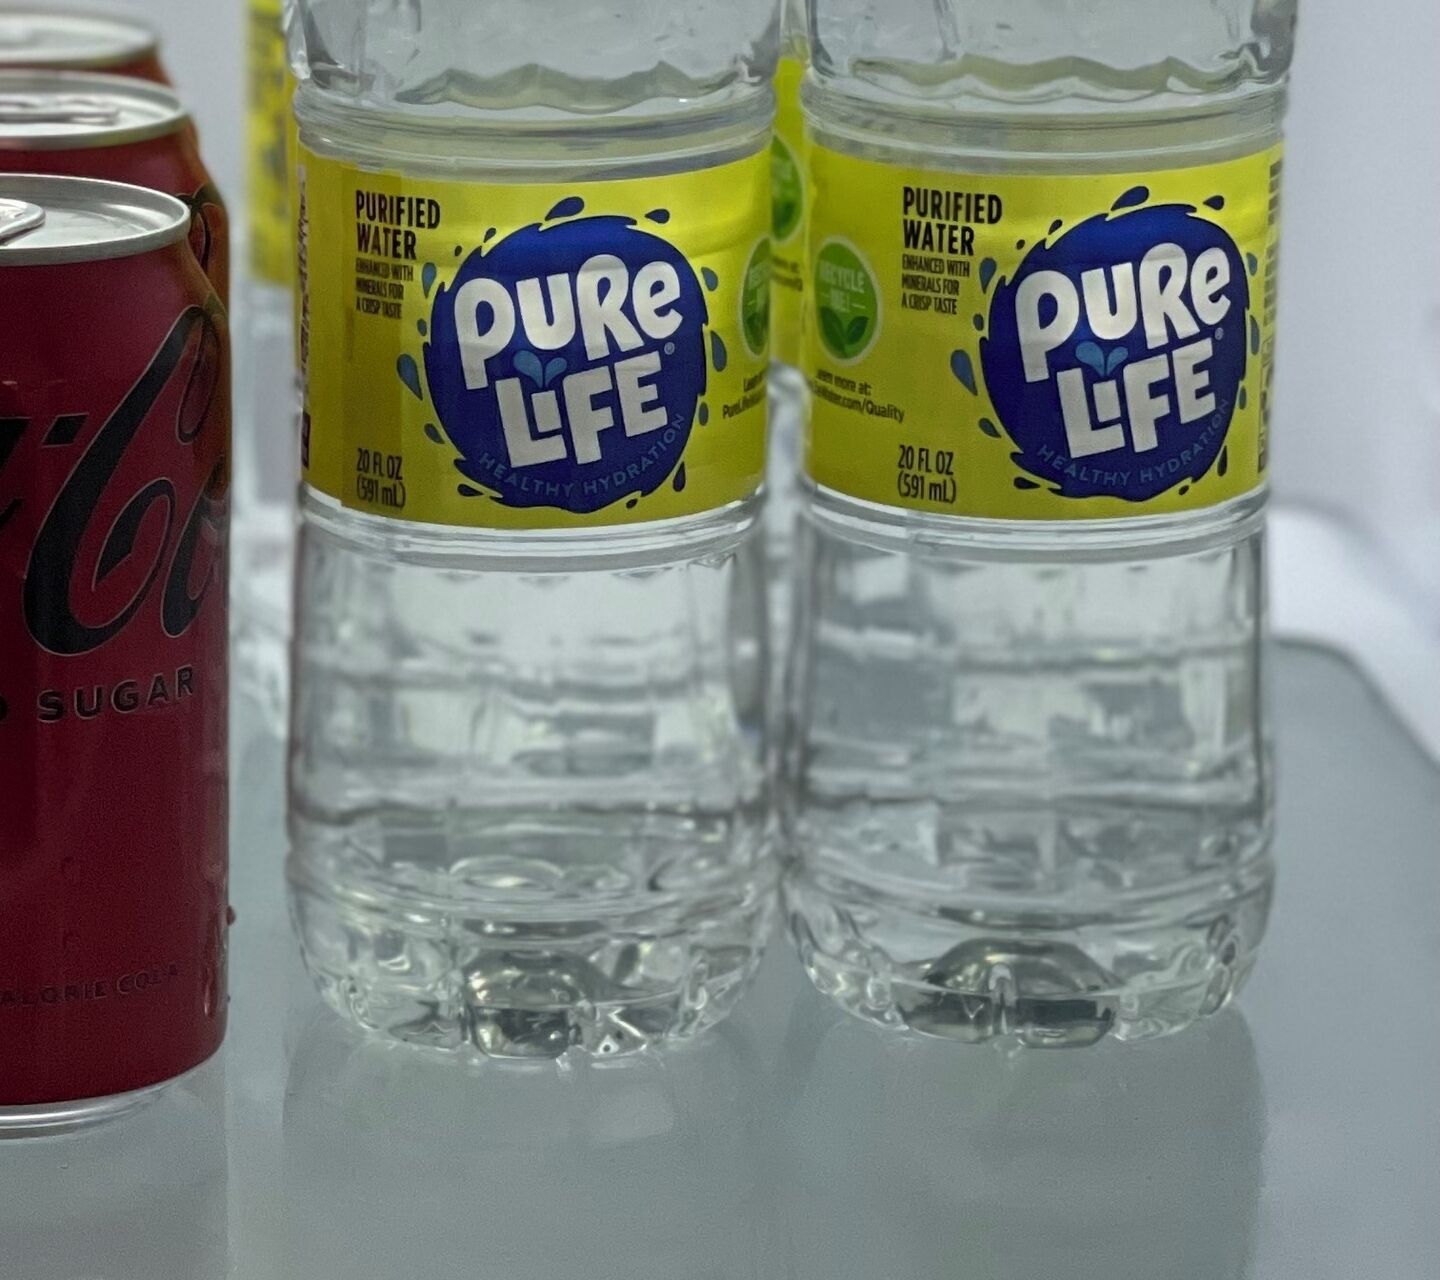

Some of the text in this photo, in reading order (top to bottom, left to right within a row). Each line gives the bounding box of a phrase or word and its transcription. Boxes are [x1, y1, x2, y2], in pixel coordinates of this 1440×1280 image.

[356, 189, 440, 229] PURIFIED
[903, 186, 1002, 224] PURIFIED
[356, 222, 416, 260] WATER
[903, 218, 974, 256] WATER
[391, 263, 413, 281] WITH
[903, 254, 970, 277] ENHANCED WITH
[388, 282, 403, 300] FOR
[902, 274, 959, 296] MINERALS FOR
[382, 301, 402, 319] TASTE
[902, 292, 957, 314] A CRISP TASTE
[479, 412, 685, 498] HEALTHY HYDRATION
[1037, 397, 1228, 487] HEALTHY HYDRATION
[357, 448, 403, 480] 20 FL OZ
[898, 445, 954, 475] 20 FL OZ
[357, 474, 406, 508] (591 mL)
[898, 470, 957, 504] (591 mL)
[38, 664, 195, 723] SUGAR
